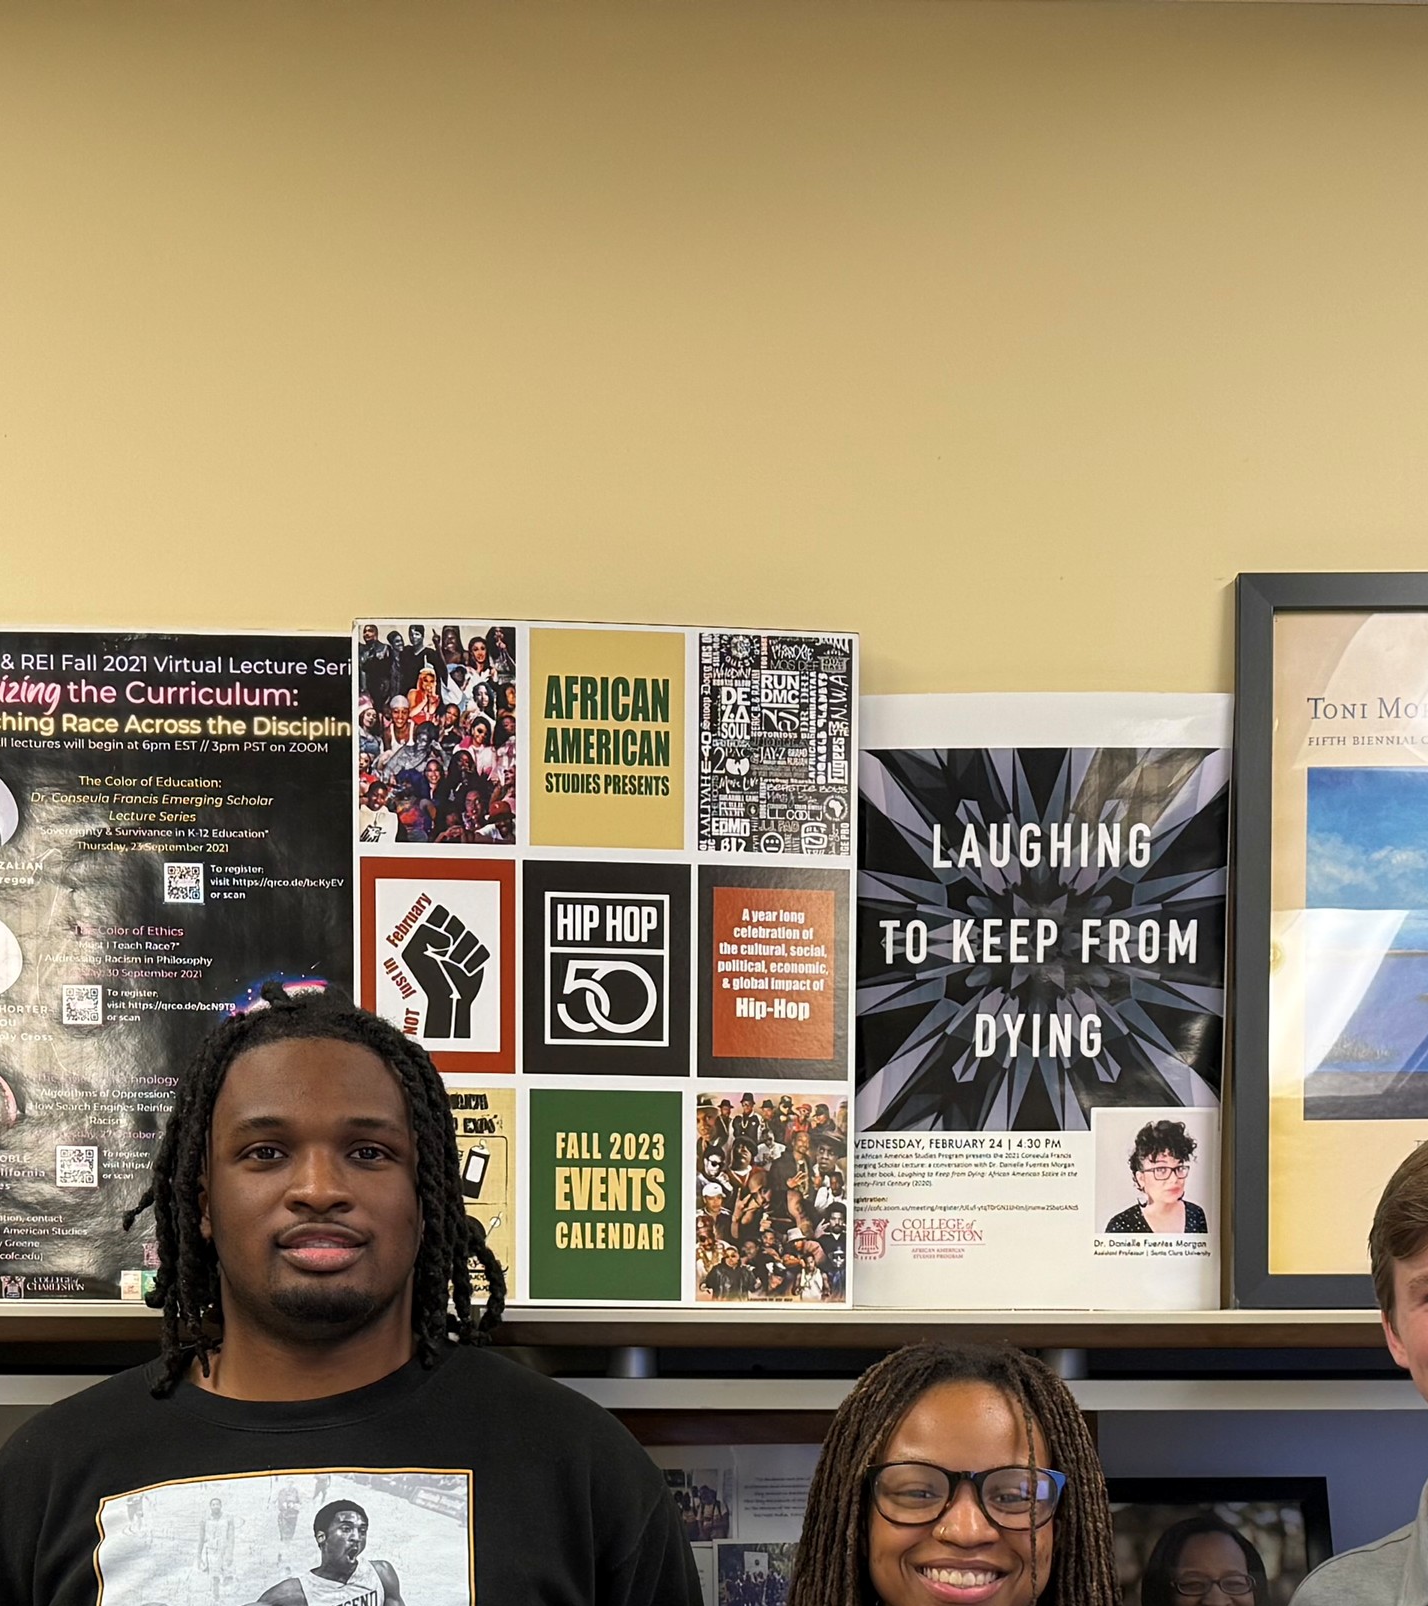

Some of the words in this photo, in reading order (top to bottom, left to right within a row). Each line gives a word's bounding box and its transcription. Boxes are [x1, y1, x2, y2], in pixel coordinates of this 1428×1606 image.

[0, 653, 14, 669] &
[21, 654, 53, 669] REI
[62, 654, 96, 670] Fall
[103, 655, 146, 671] 2021
[153, 655, 221, 673] Virtual
[229, 657, 307, 674] Lecture
[67, 680, 116, 703] the
[126, 681, 297, 706] Curriculum:
[544, 675, 669, 722] AFRICAN
[62, 713, 118, 733] Race
[124, 714, 201, 734] Across
[206, 715, 246, 735] the
[544, 727, 669, 768] AMERICAN
[78, 775, 101, 785] The
[105, 776, 137, 786] Color
[140, 776, 152, 786] of
[156, 776, 221, 787] Education:
[545, 772, 600, 793] STUDIES
[604, 774, 669, 796] PRESENTS
[930, 821, 1154, 869] LAUGHING
[385, 892, 432, 948] February
[557, 904, 599, 941] HIP
[606, 905, 656, 942] HOP
[880, 919, 927, 964] TO
[952, 919, 1059, 964] KEEP
[1082, 919, 1198, 964] FROM
[383, 957, 399, 975] in
[391, 971, 417, 1000] just
[555, 958, 656, 1033] 50
[402, 1007, 420, 1035] NOT
[975, 1014, 1101, 1057] DYING
[556, 1132, 601, 1158] FALL
[610, 1133, 664, 1160] 2023
[929, 1139, 986, 1149] FEBRUARY
[989, 1139, 1003, 1149] 24
[1016, 1139, 1041, 1149] 4:30
[1045, 1139, 1062, 1149] PM
[555, 1166, 664, 1212] EVENTS
[556, 1222, 663, 1249] CALENDAR
